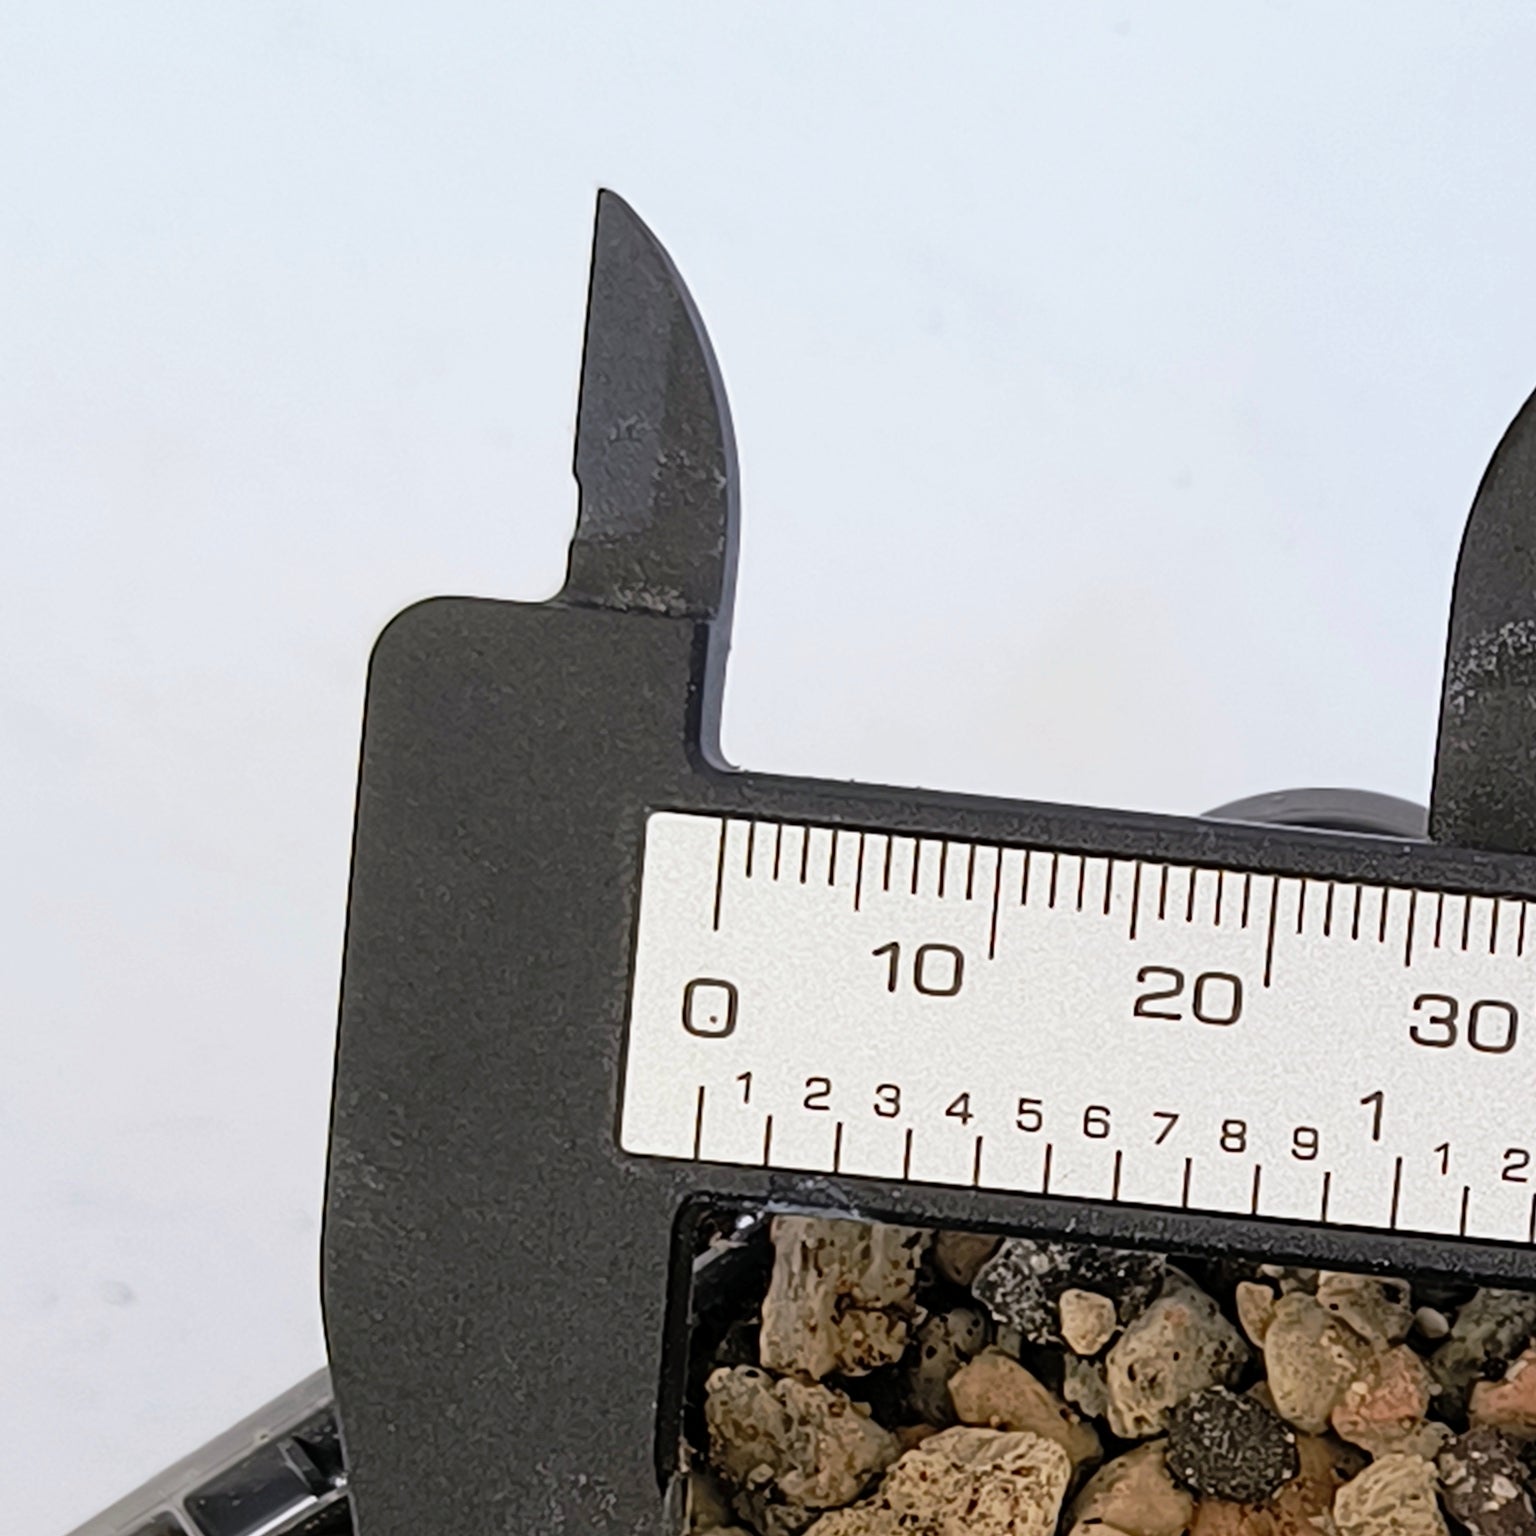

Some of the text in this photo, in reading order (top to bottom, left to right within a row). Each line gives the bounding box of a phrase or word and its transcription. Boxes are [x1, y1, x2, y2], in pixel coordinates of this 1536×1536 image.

[682, 977, 738, 1039] 0
[872, 941, 965, 997] 10
[1133, 966, 1243, 1026] 20
[1409, 994, 1518, 1053] 30
[736, 1071, 754, 1105] 1
[802, 1076, 832, 1111] 2
[873, 1083, 901, 1118] 3
[945, 1092, 974, 1126] 4
[1015, 1098, 1044, 1133] 5
[1082, 1105, 1112, 1140] 6
[1152, 1111, 1180, 1146] 7
[1219, 1118, 1248, 1154] 8
[1291, 1126, 1320, 1161] 9
[1360, 1090, 1385, 1141] 1
[1433, 1142, 1451, 1176] 1
[1501, 1148, 1531, 1183] 2
